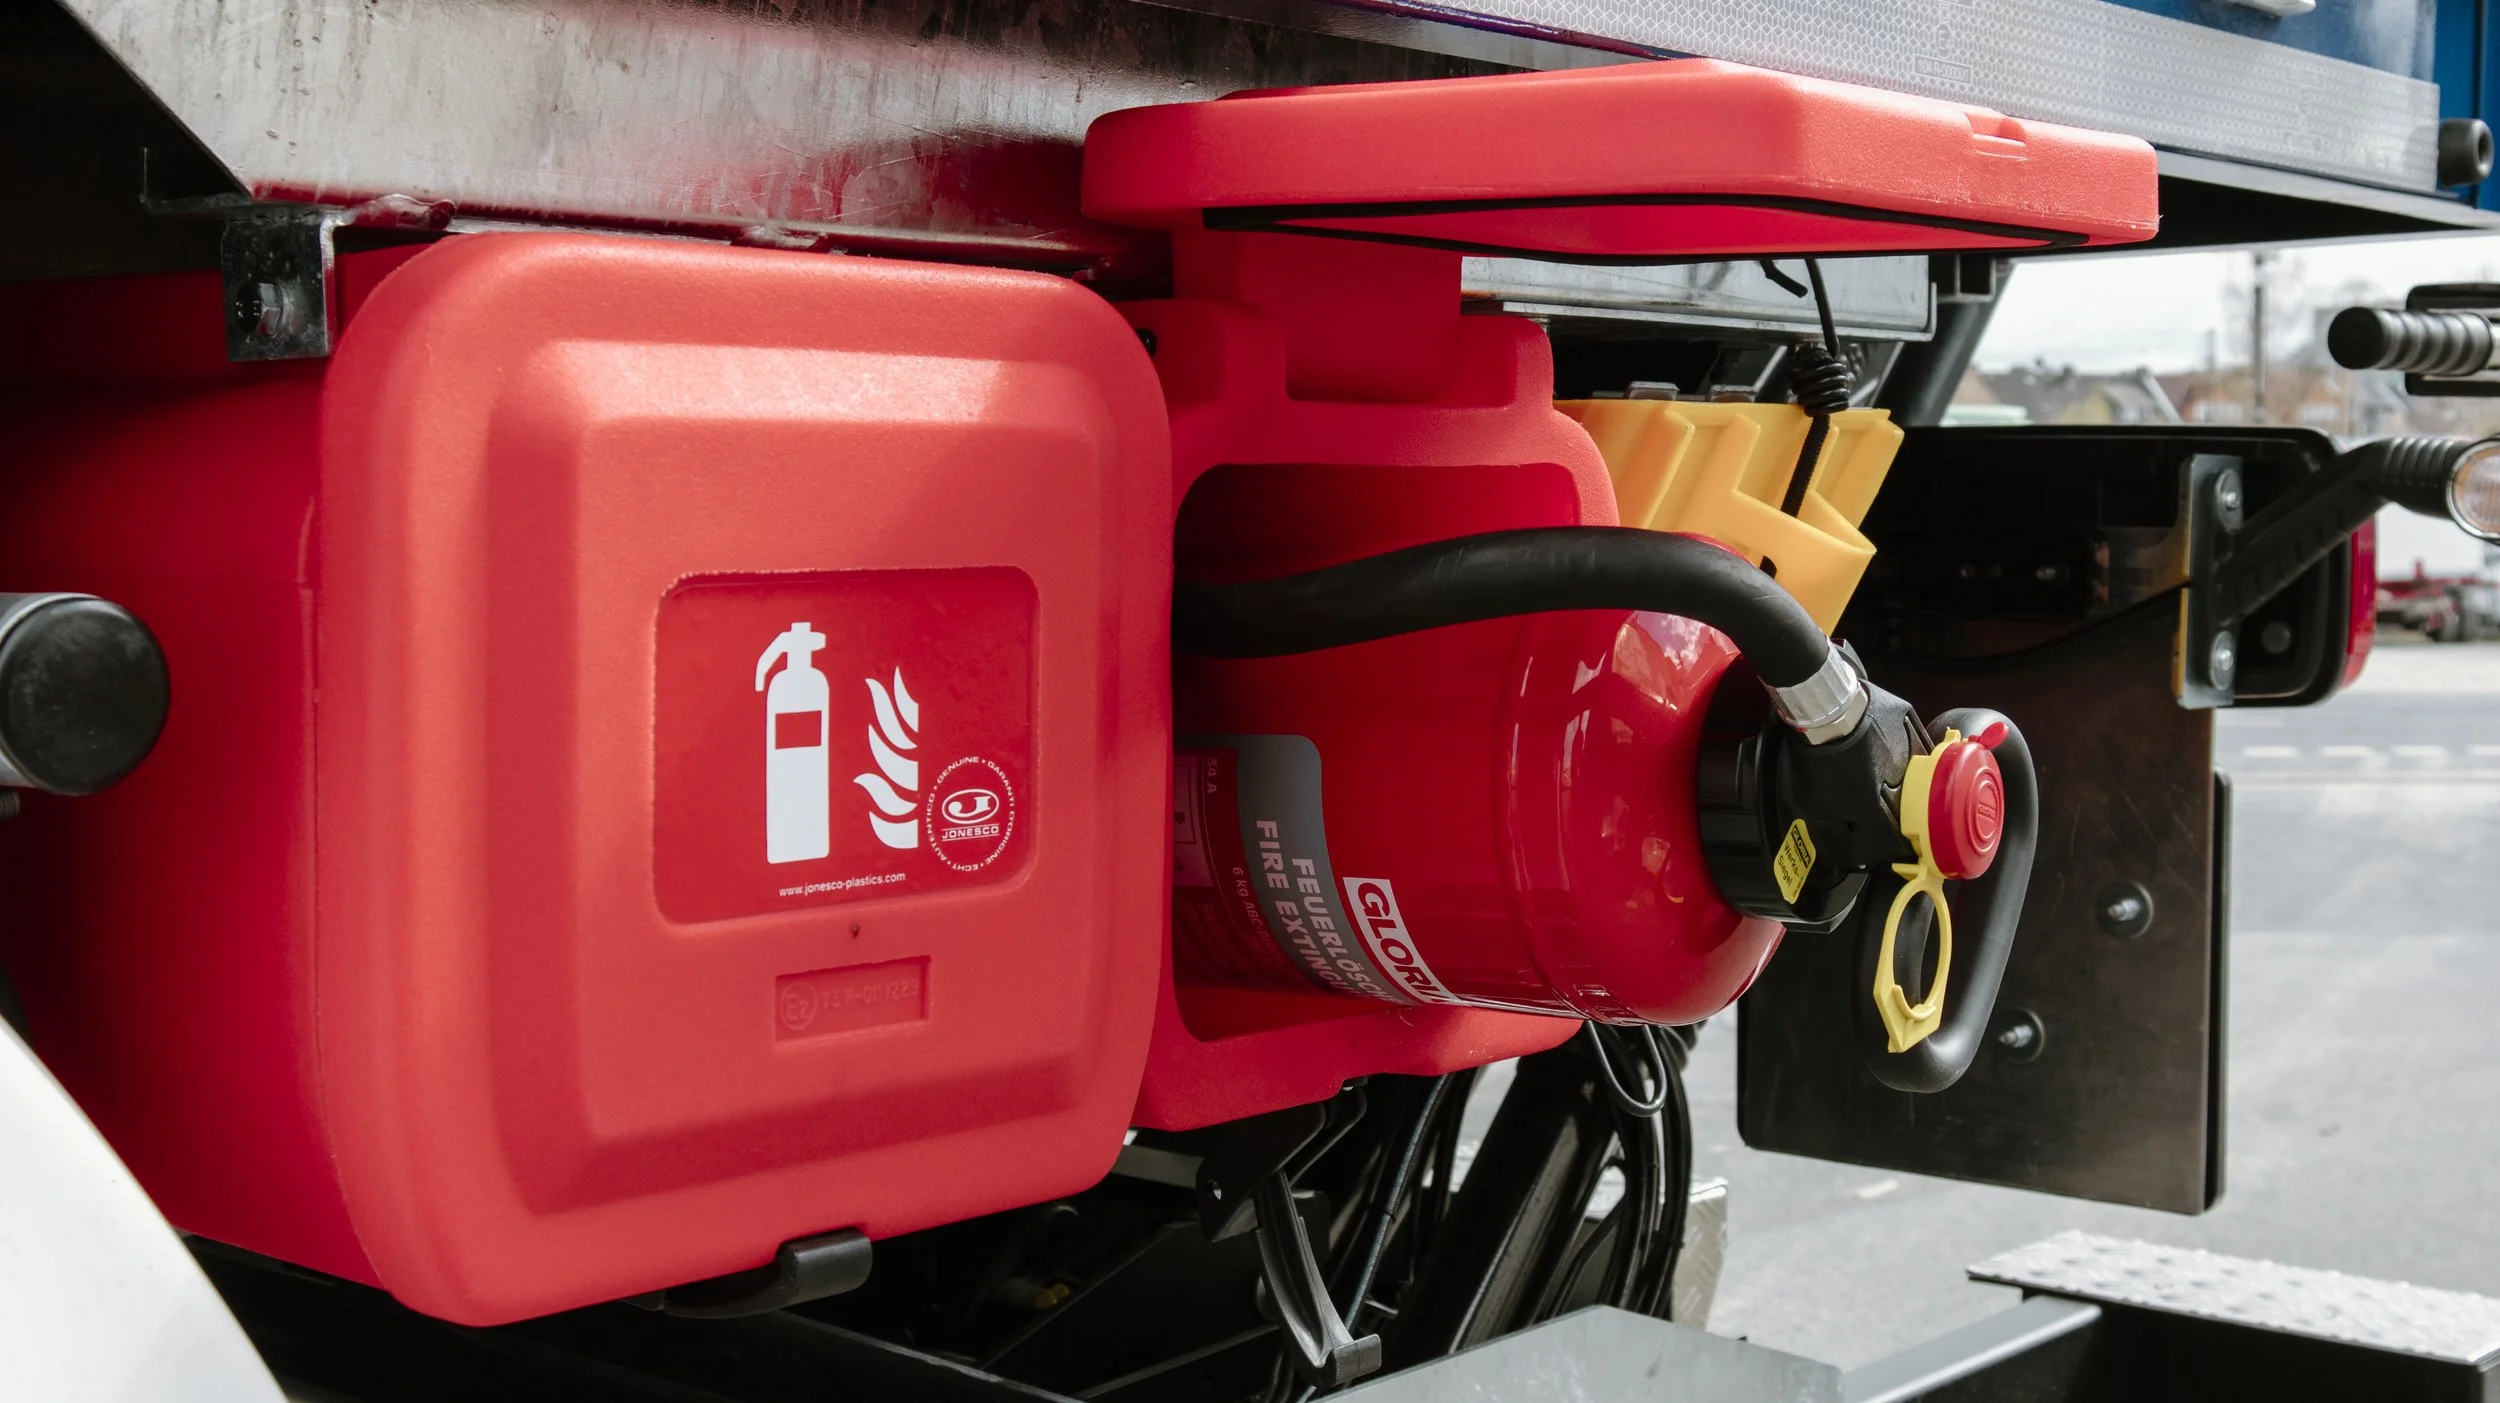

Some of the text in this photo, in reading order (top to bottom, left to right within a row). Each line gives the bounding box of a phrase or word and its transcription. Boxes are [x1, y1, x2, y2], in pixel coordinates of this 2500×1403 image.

[937, 756, 979, 784] GENUINE
[987, 761, 1014, 807] GARANTI
[1206, 782, 1218, 795] A
[926, 793, 947, 861] AUTENTICO
[942, 825, 999, 840] JONESCO
[1256, 820, 1290, 889] FIRE
[1784, 840, 1800, 877] Werks-
[1791, 827, 1811, 867] GLORIA
[952, 862, 979, 873] ECHT
[1232, 866, 1244, 876] 6
[1777, 854, 1793, 888] Siegel
[779, 873, 905, 896] www.jonesco-plastics.com
[1236, 880, 1250, 898] kg
